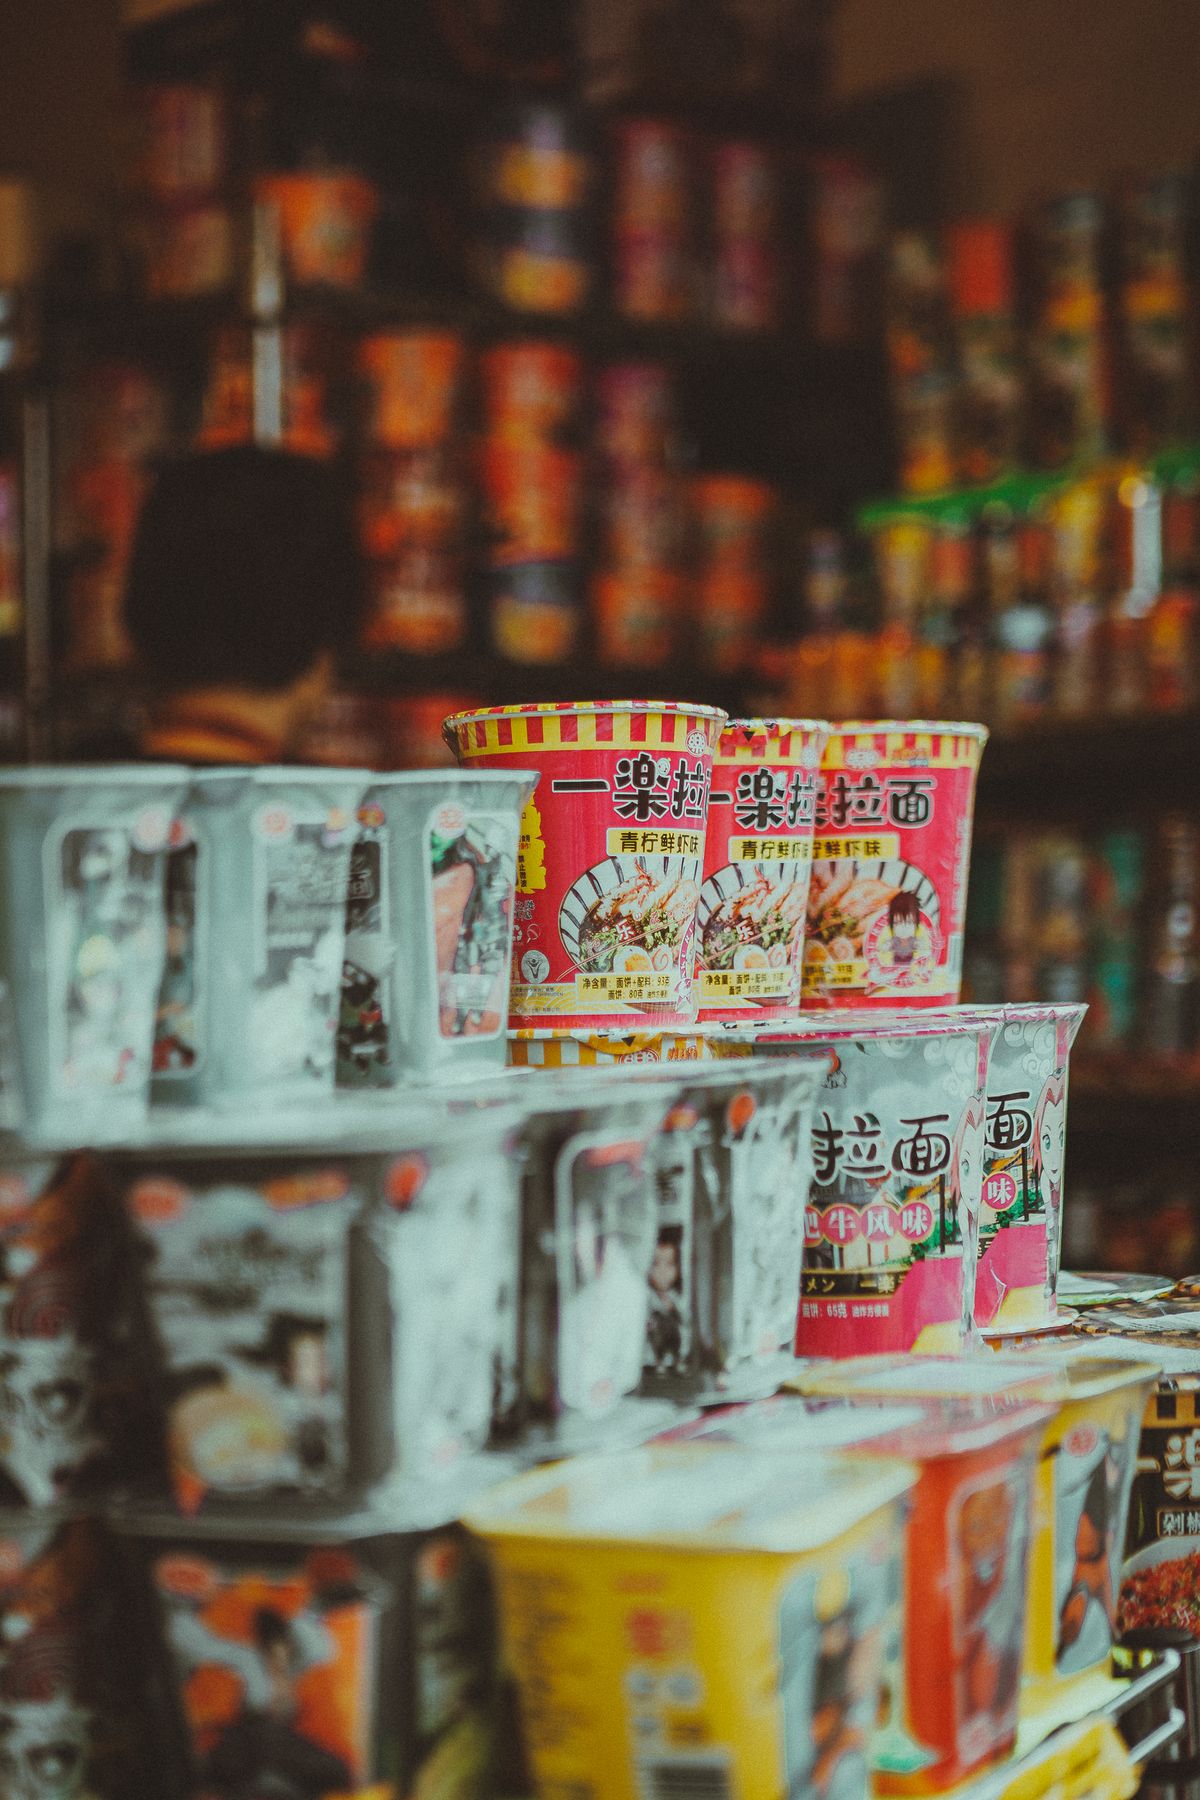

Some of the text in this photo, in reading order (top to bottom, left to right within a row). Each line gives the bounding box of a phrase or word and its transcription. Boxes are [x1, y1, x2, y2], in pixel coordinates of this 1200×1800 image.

[619, 831, 700, 855] 青柠鲜虾味
[984, 1090, 1033, 1151] 面
[810, 1111, 951, 1185] 拉面
[987, 1180, 1013, 1205] 味
